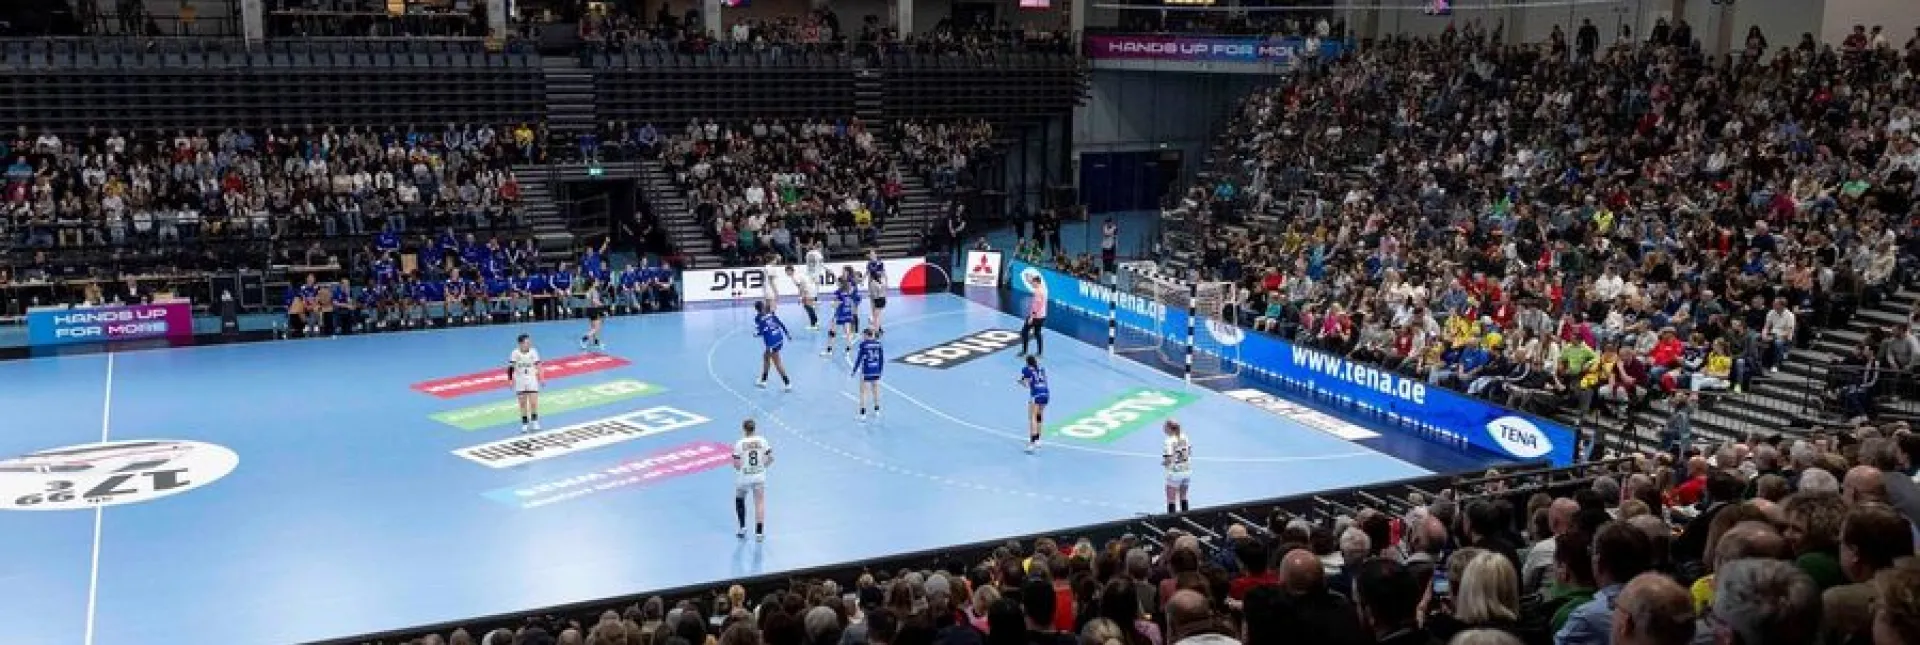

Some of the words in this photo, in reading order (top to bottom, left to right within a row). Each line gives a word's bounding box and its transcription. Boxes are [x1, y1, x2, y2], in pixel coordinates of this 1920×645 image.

[1108, 41, 1176, 54] HANDS
[1180, 43, 1208, 55] UP
[1212, 45, 1252, 55] FOR
[54, 311, 133, 325] HANDS
[136, 309, 168, 319] UP
[55, 326, 102, 338] FOR
[108, 321, 167, 334] MORE
[1500, 423, 1538, 449] TENA
[748, 450, 758, 466] 8
